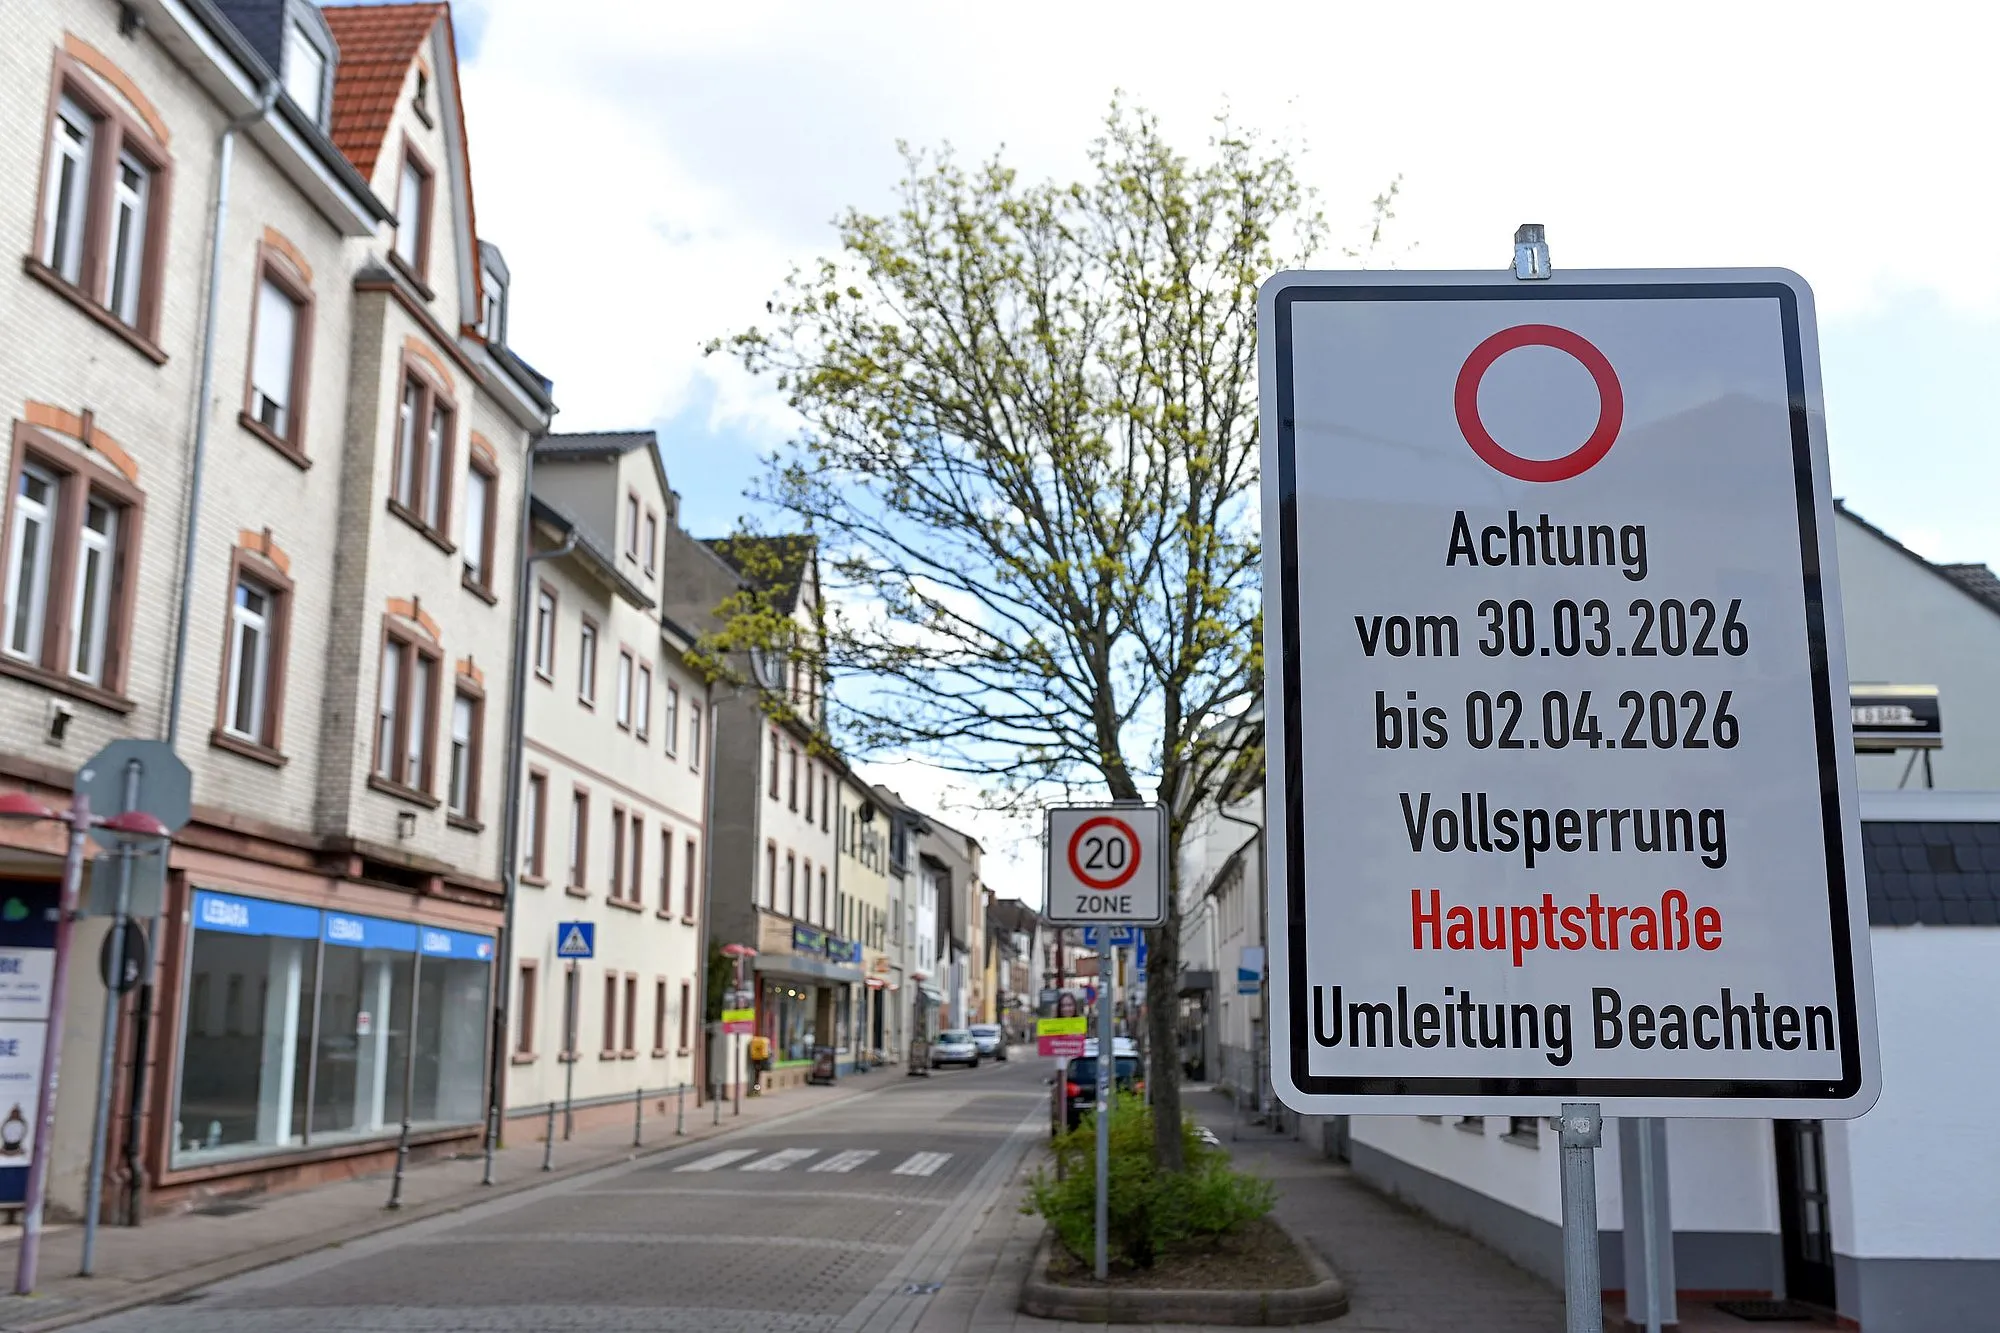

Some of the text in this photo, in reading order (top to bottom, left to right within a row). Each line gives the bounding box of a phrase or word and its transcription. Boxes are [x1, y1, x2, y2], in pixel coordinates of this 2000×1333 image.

[1446, 511, 1648, 582] Achtung
[1354, 599, 1749, 657] vom 30.03.2026
[1375, 691, 1740, 750] bis 02.04.2026
[1085, 837, 1125, 869] 20
[1399, 792, 1728, 869] Vollsperrung
[1076, 895, 1132, 914] ZONE
[1411, 889, 1722, 967] Hauptstraße
[1313, 985, 1836, 1067] Umleitung Beachten
